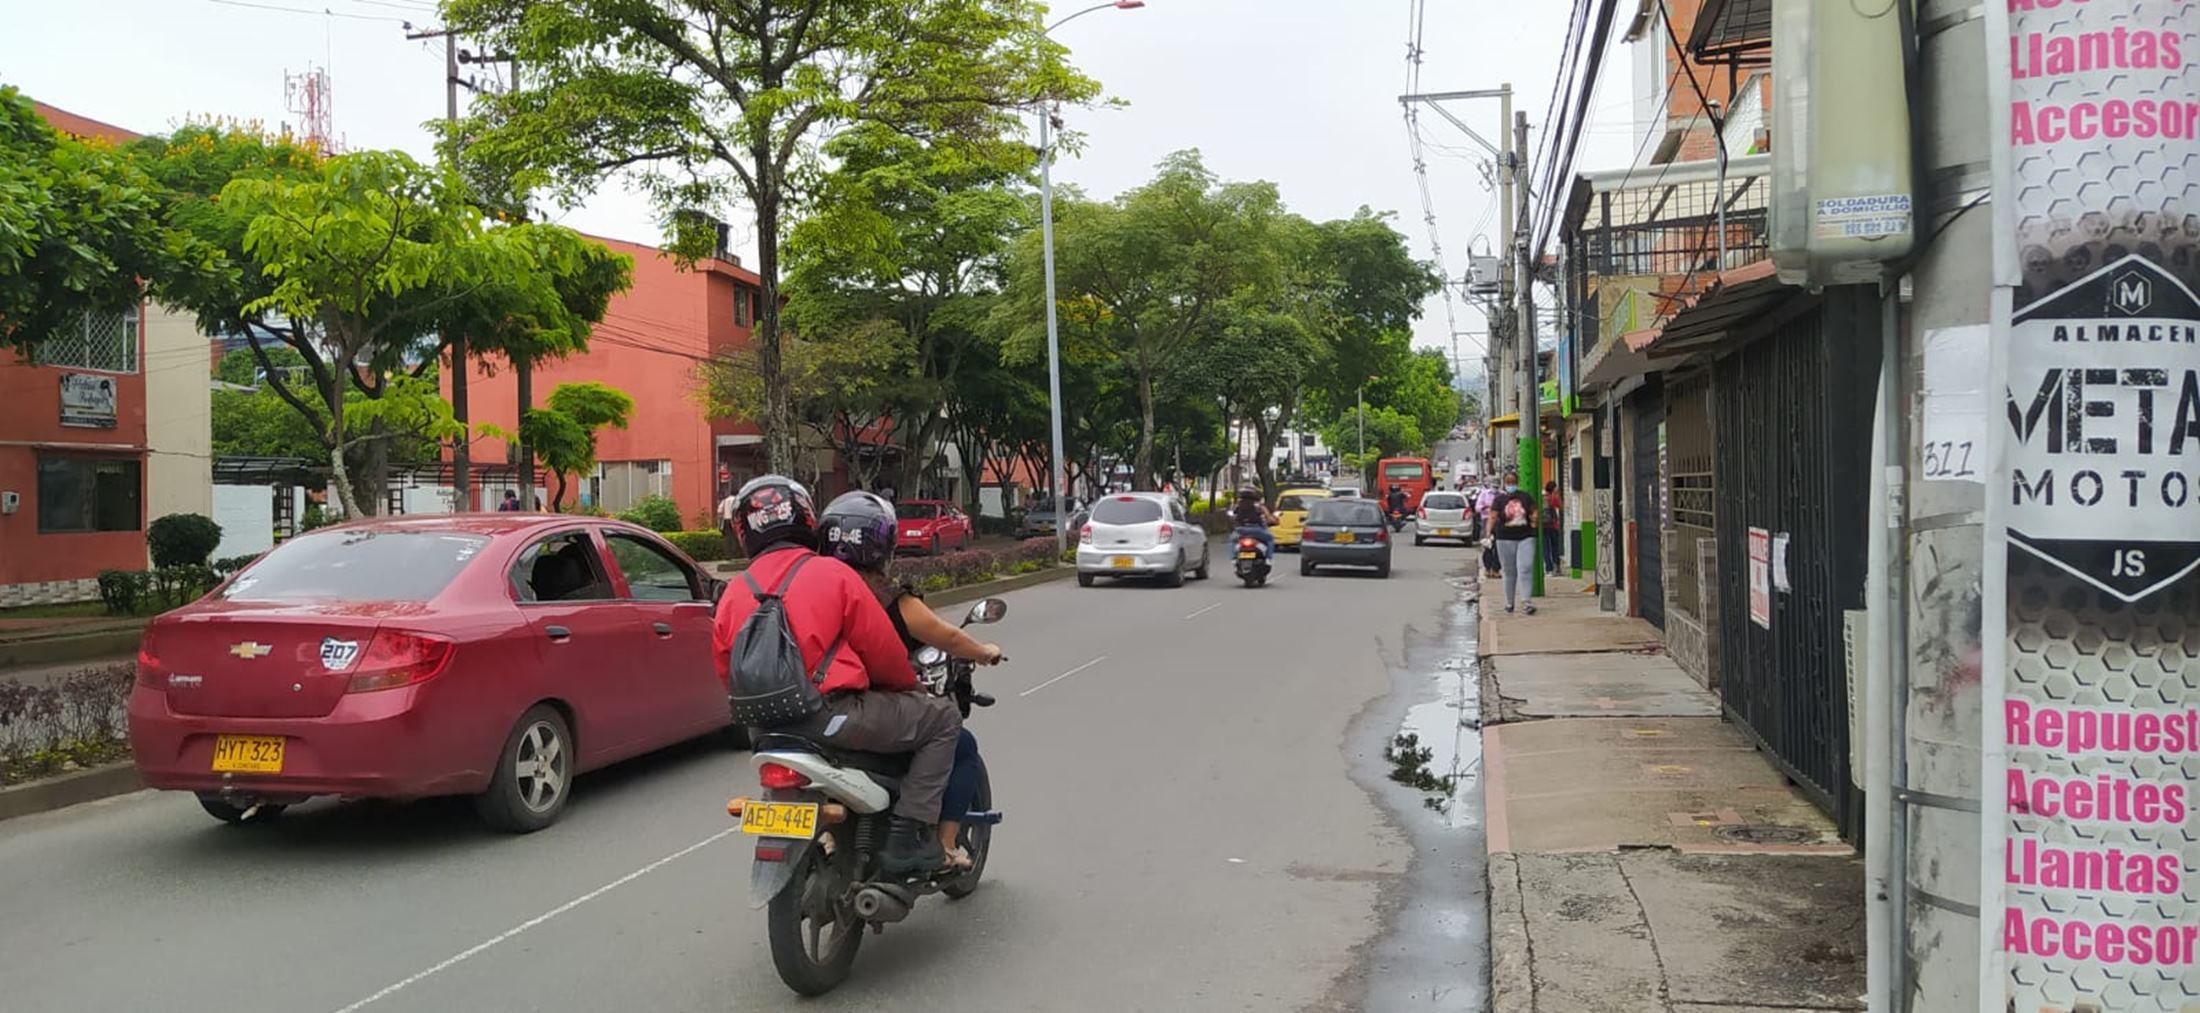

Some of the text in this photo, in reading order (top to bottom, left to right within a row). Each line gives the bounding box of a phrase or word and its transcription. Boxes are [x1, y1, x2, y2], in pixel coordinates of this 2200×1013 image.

[2010, 26, 2182, 80] Llantas
[1816, 195, 1909, 208] SOLDADURA
[1831, 203, 1909, 215] DOMICILIO
[2120, 281, 2145, 307] M
[2053, 324, 2195, 343] ALMACEN
[2012, 469, 2200, 508] MOTO
[2111, 549, 2146, 578] JS
[322, 644, 357, 659] 207
[217, 739, 283, 762] HYT 323
[2007, 768, 2184, 823] Aceites
[2006, 837, 2179, 894] Llantas
[2004, 907, 2198, 965] Accesor
